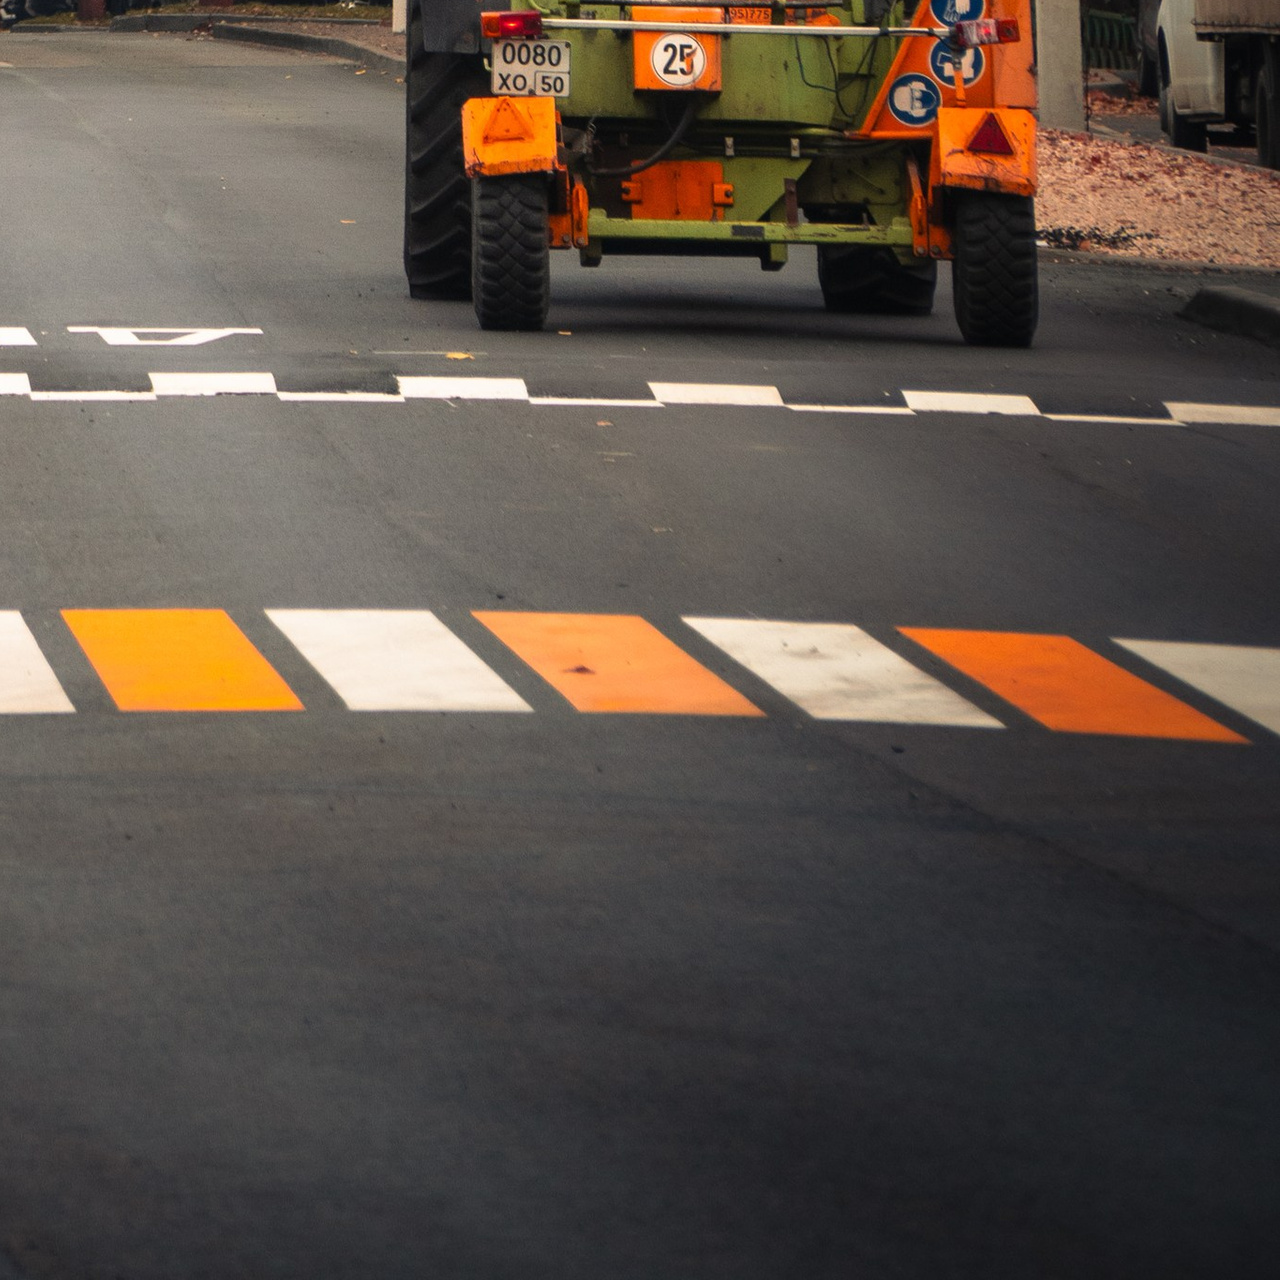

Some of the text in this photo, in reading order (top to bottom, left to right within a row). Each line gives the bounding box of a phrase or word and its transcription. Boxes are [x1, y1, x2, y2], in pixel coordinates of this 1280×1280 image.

[502, 43, 561, 67] 0080
[662, 42, 695, 75] 25
[541, 76, 564, 93] 50
